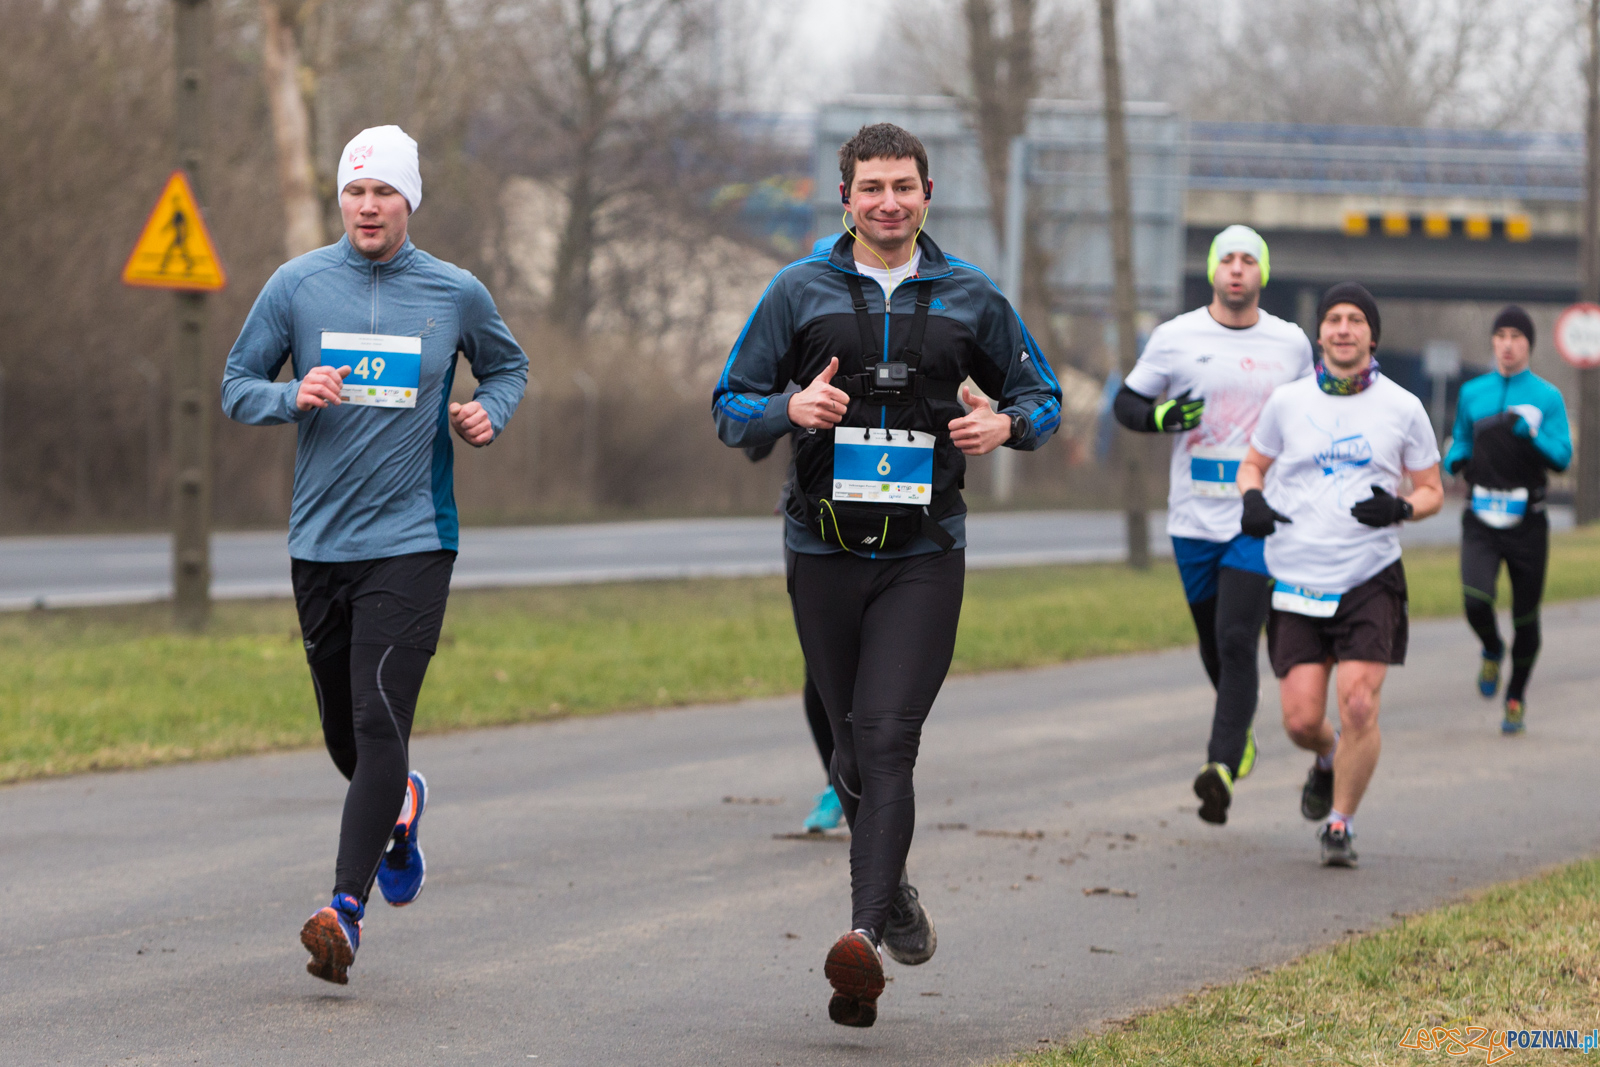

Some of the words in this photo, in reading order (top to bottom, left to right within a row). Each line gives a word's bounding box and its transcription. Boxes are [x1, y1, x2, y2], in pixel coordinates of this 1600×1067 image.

[354, 357, 386, 380] 49
[877, 453, 891, 476] 6
[1217, 463, 1224, 480] 1
